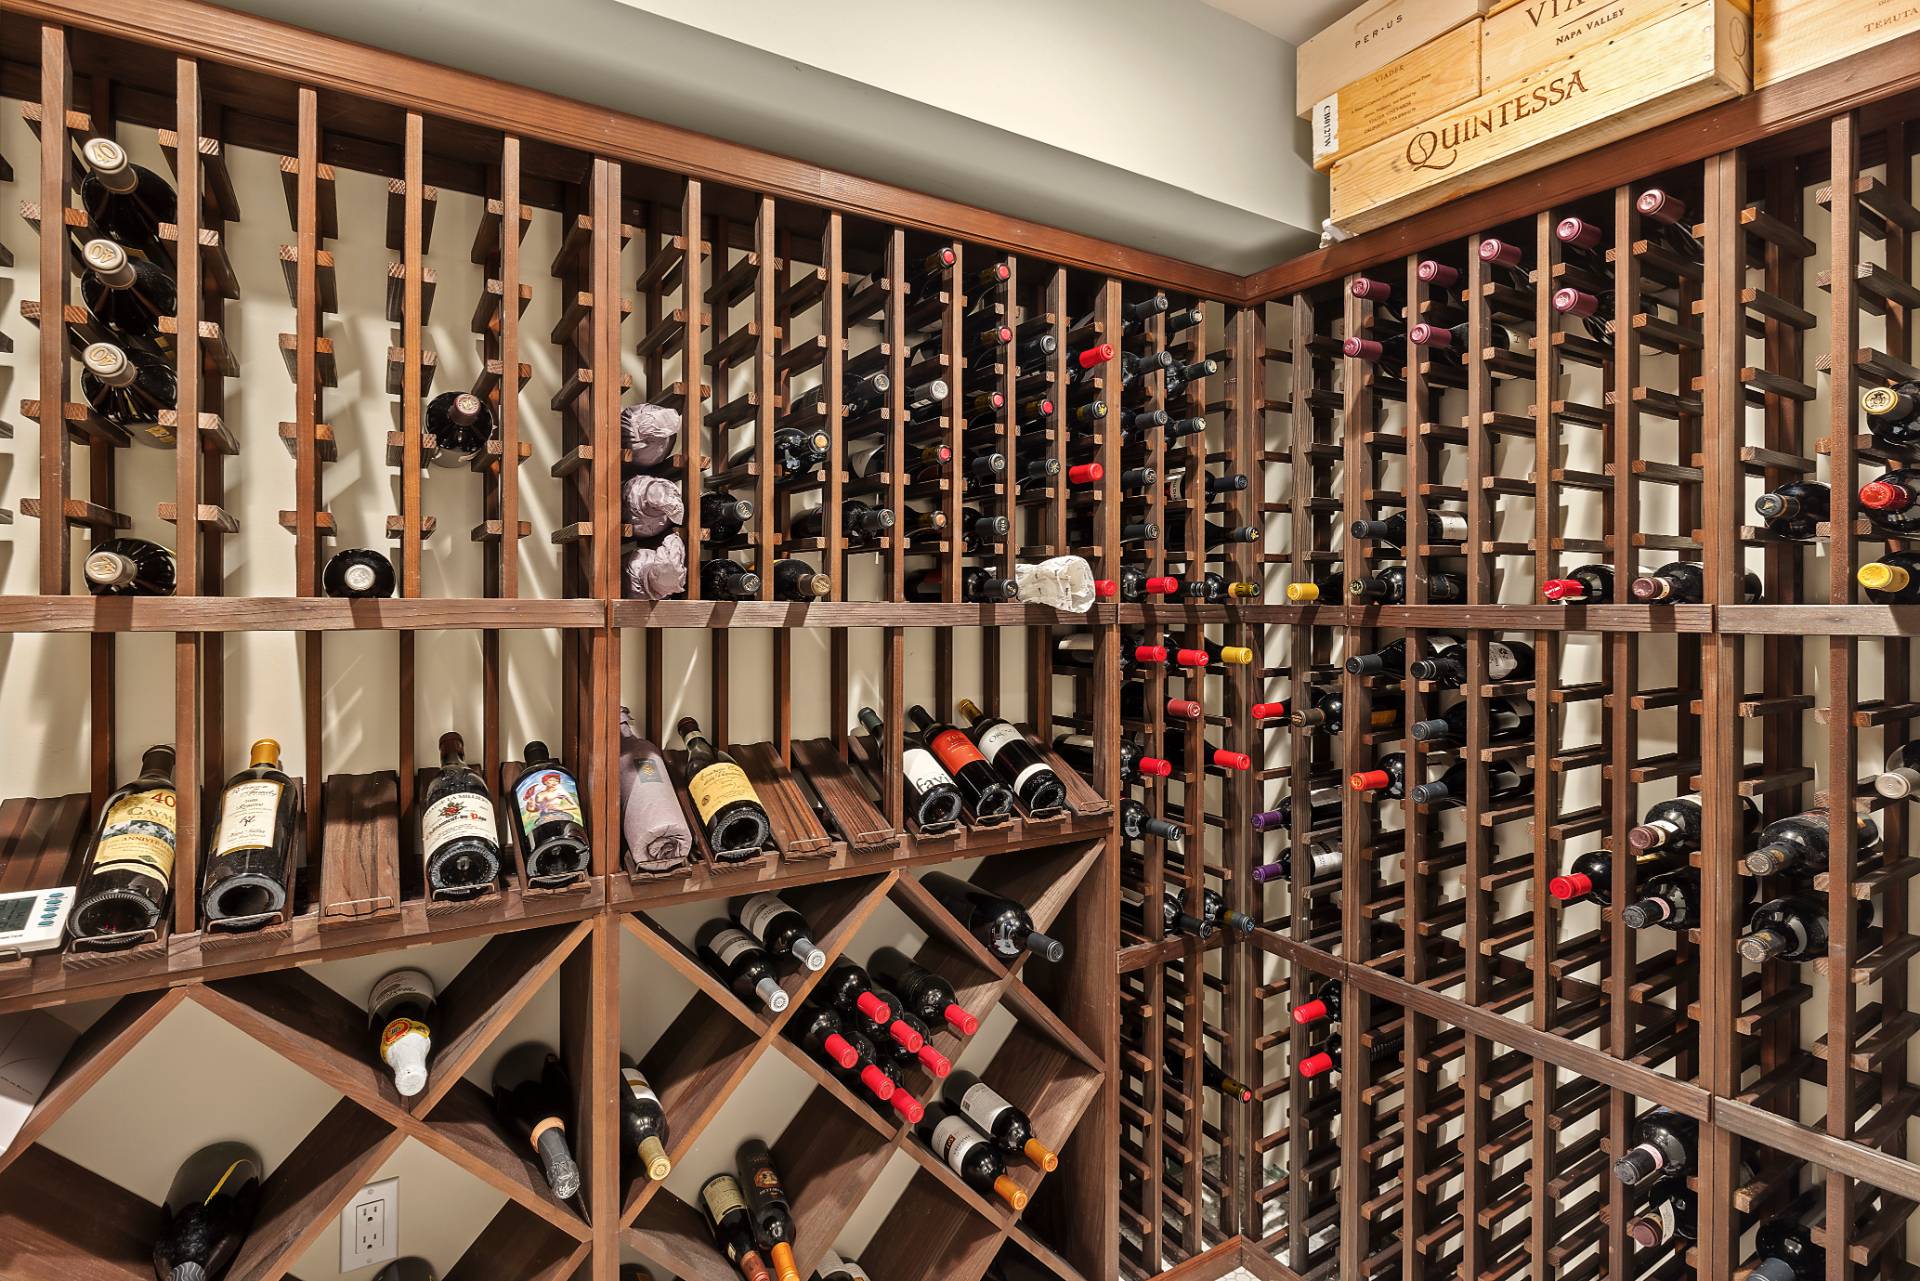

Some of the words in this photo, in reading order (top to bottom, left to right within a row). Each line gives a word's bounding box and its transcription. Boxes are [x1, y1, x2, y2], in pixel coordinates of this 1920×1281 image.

[1555, 28, 1583, 46] NAPA
[1586, 8, 1625, 31] VALLEY
[1405, 69, 1589, 172] QUINTESSA
[150, 791, 176, 808] 40
